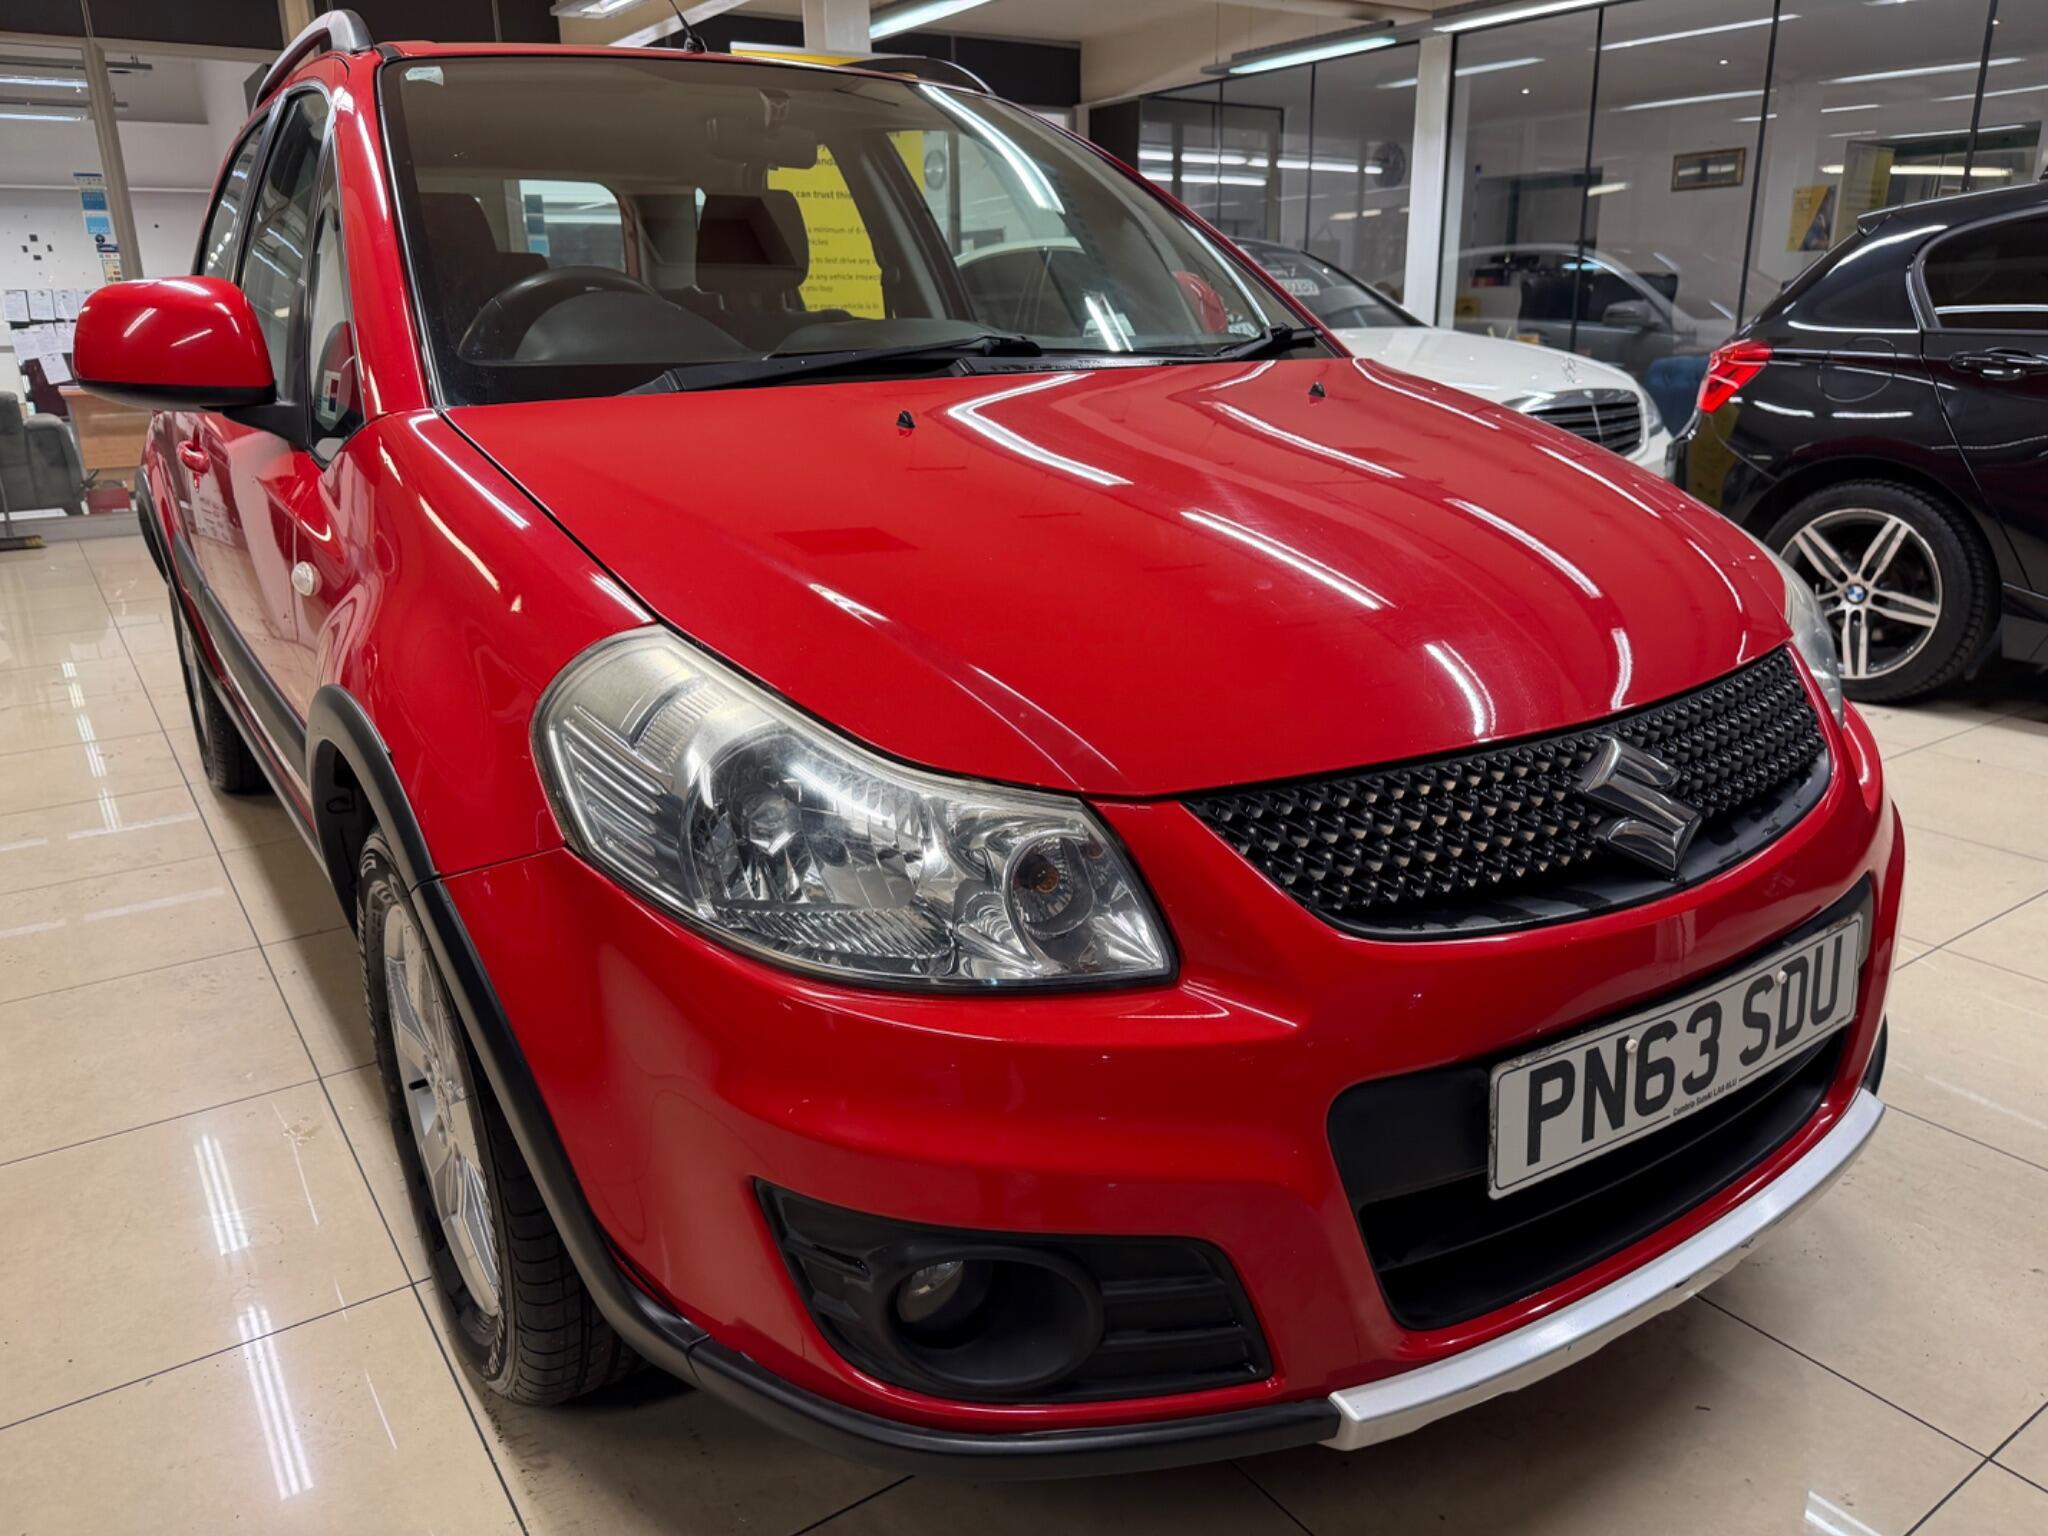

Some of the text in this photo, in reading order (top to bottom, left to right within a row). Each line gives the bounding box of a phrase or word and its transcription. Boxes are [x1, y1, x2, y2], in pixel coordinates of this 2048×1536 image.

[795, 191, 811, 199] can
[813, 190, 834, 199] trust
[1526, 934, 1843, 1167] PN63 SDU
[1673, 1101, 1695, 1117] Cumbria
[1696, 1090, 1713, 1106] Suzuki
